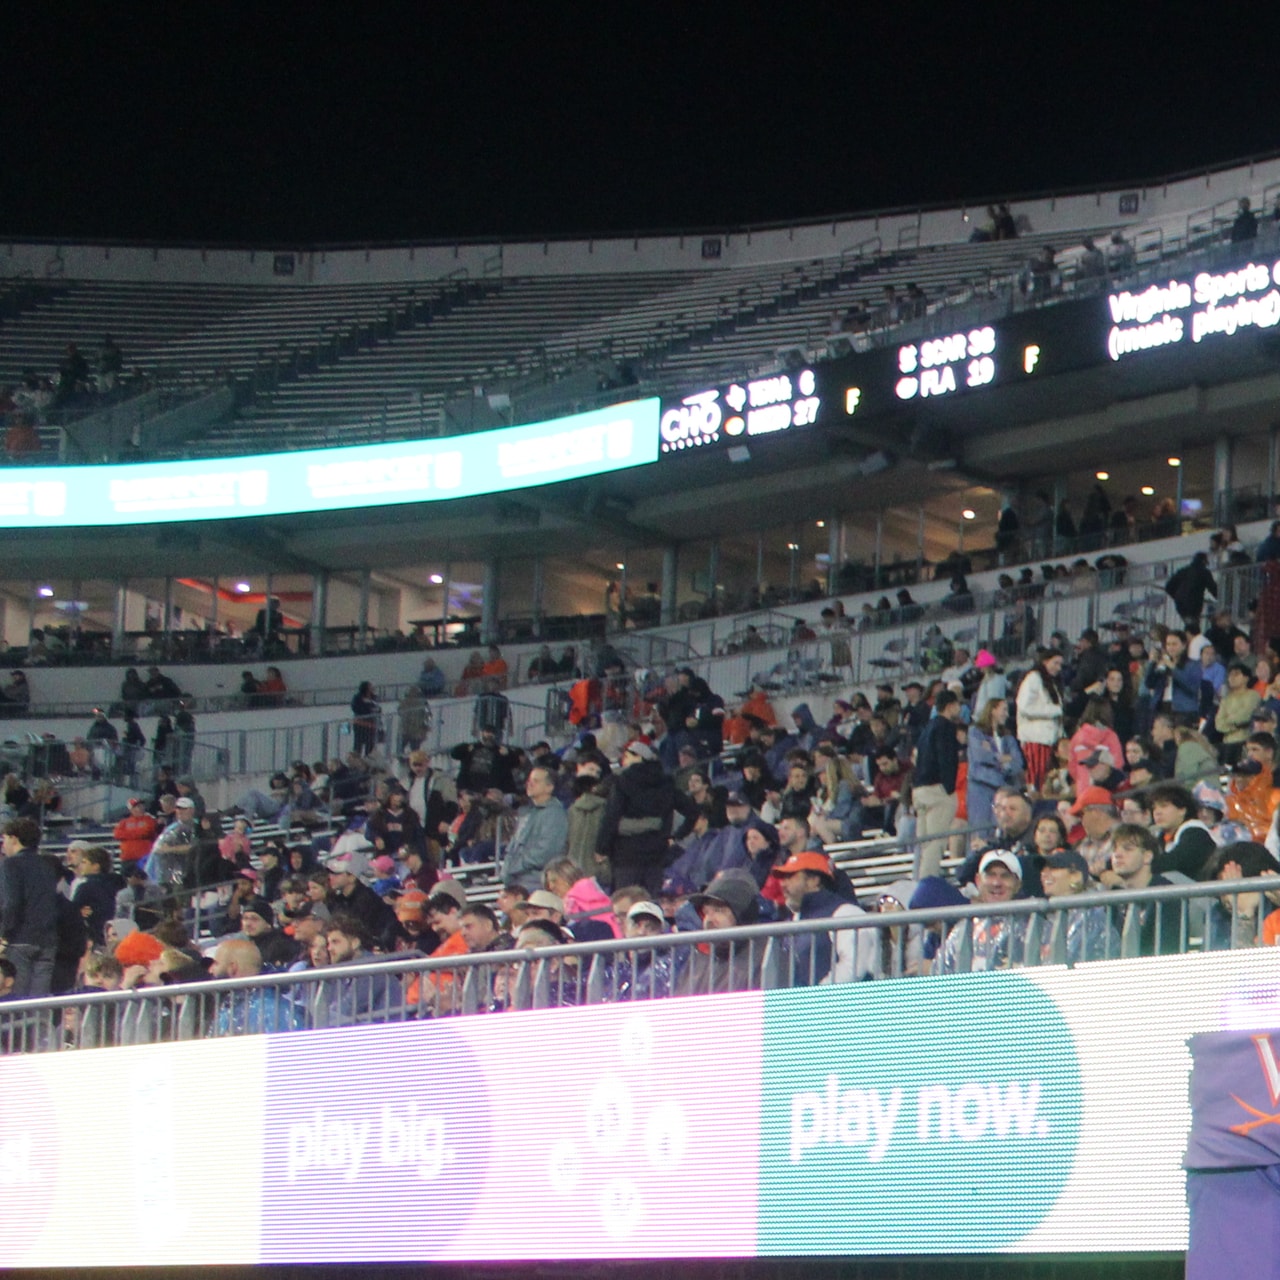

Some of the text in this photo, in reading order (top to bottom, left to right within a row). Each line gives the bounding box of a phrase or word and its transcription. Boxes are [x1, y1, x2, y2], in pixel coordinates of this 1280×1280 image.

[1110, 282, 1190, 323] Virginia
[1194, 263, 1268, 305] Sports
[1108, 291, 1280, 360] (music playing)
[921, 367, 955, 396] FLA
[1024, 345, 1040, 373] F
[847, 389, 860, 413] F
[288, 1103, 457, 1181] play big.
[790, 1076, 1050, 1164] play now.
